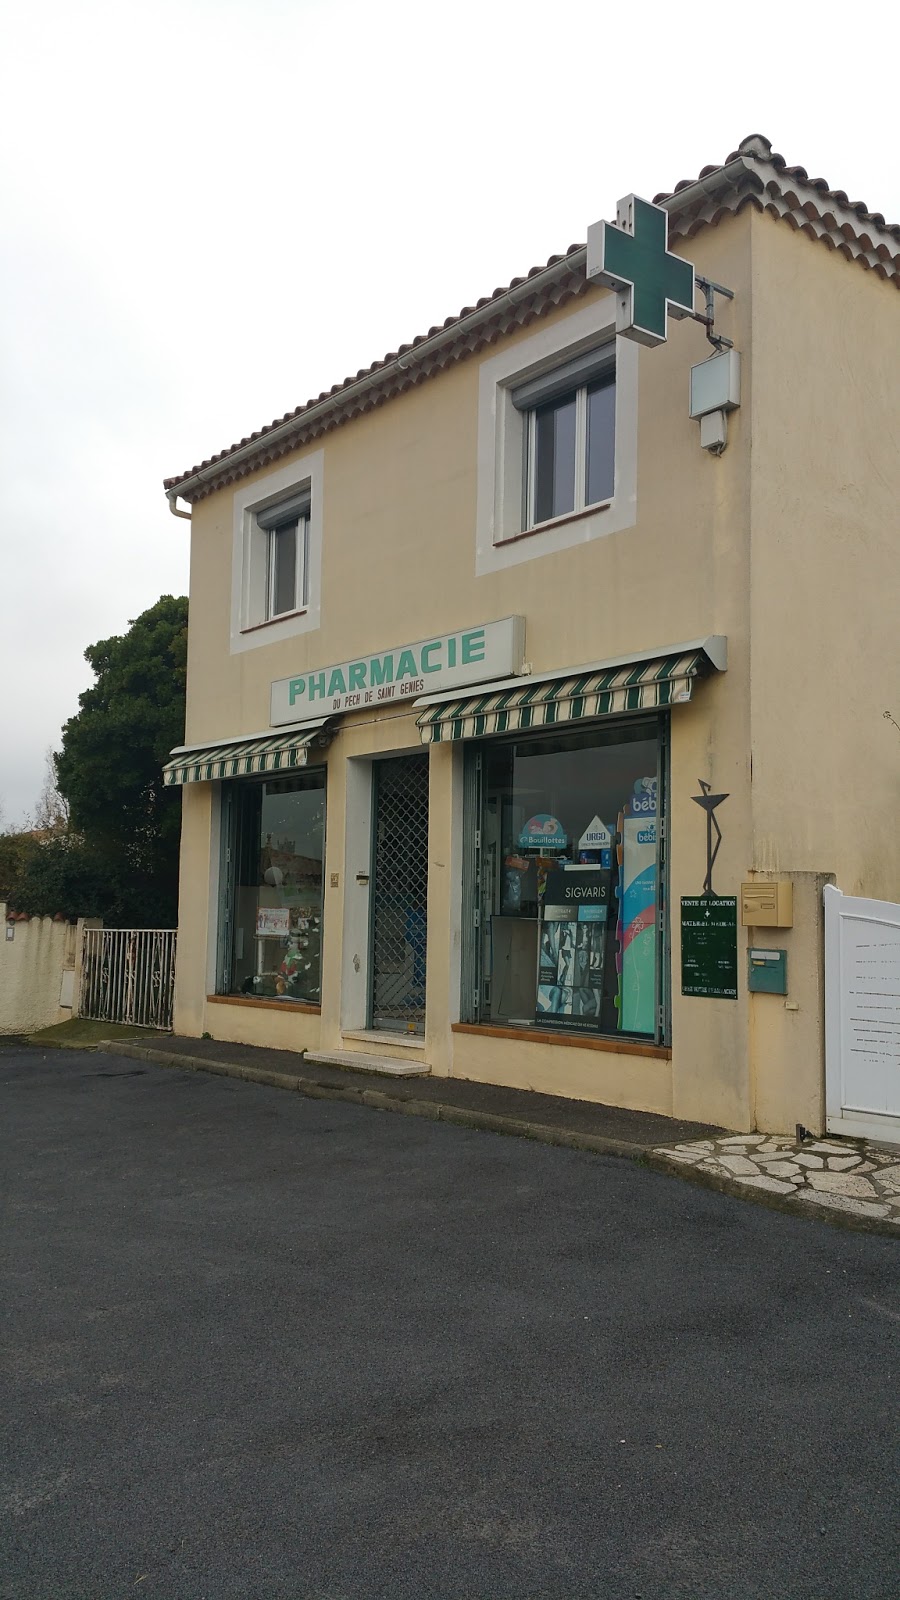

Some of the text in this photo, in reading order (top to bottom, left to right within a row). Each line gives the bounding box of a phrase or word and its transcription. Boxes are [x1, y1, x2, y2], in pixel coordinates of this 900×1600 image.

[288, 629, 486, 706] PHARMACIE
[332, 679, 424, 710] DU PECH DE SAINT GENIES
[633, 796, 657, 812] béb
[528, 835, 565, 845] Bouillottes
[586, 831, 606, 842] URGO
[638, 831, 657, 842] bébi
[564, 886, 606, 898] SIGVARIS
